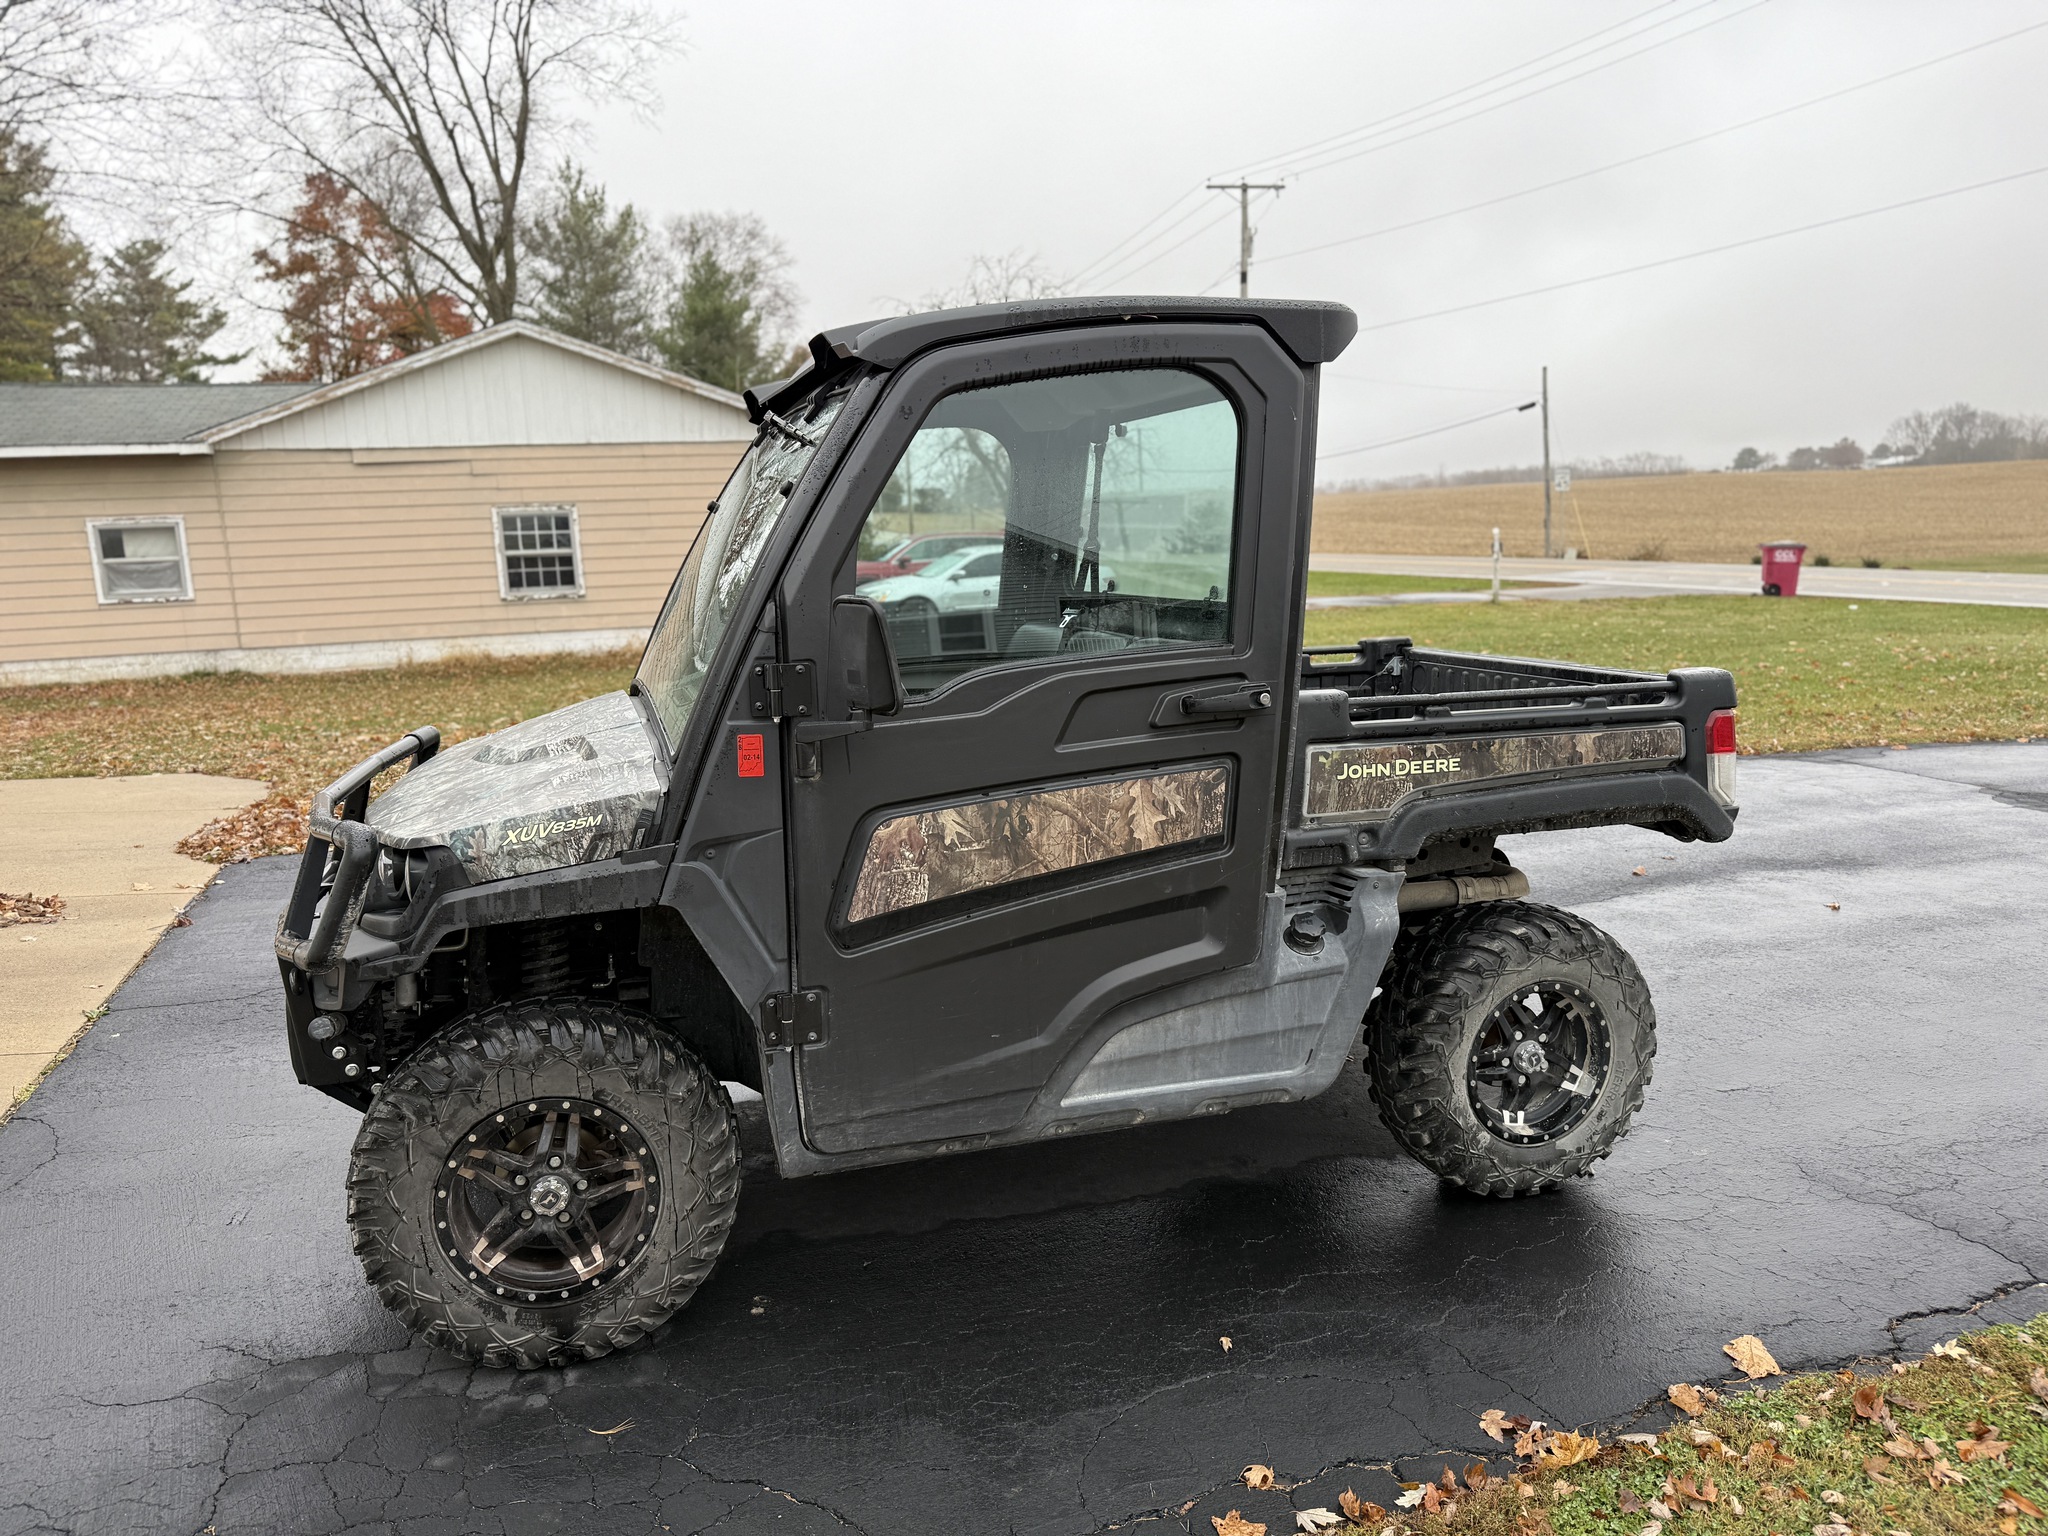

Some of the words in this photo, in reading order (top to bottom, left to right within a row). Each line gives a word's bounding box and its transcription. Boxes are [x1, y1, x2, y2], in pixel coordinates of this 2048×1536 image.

[1337, 762, 1391, 780] JOHN
[1395, 758, 1461, 775] DEERE
[501, 814, 604, 846] XUV835M
[594, 1086, 670, 1150] ERRABITE
